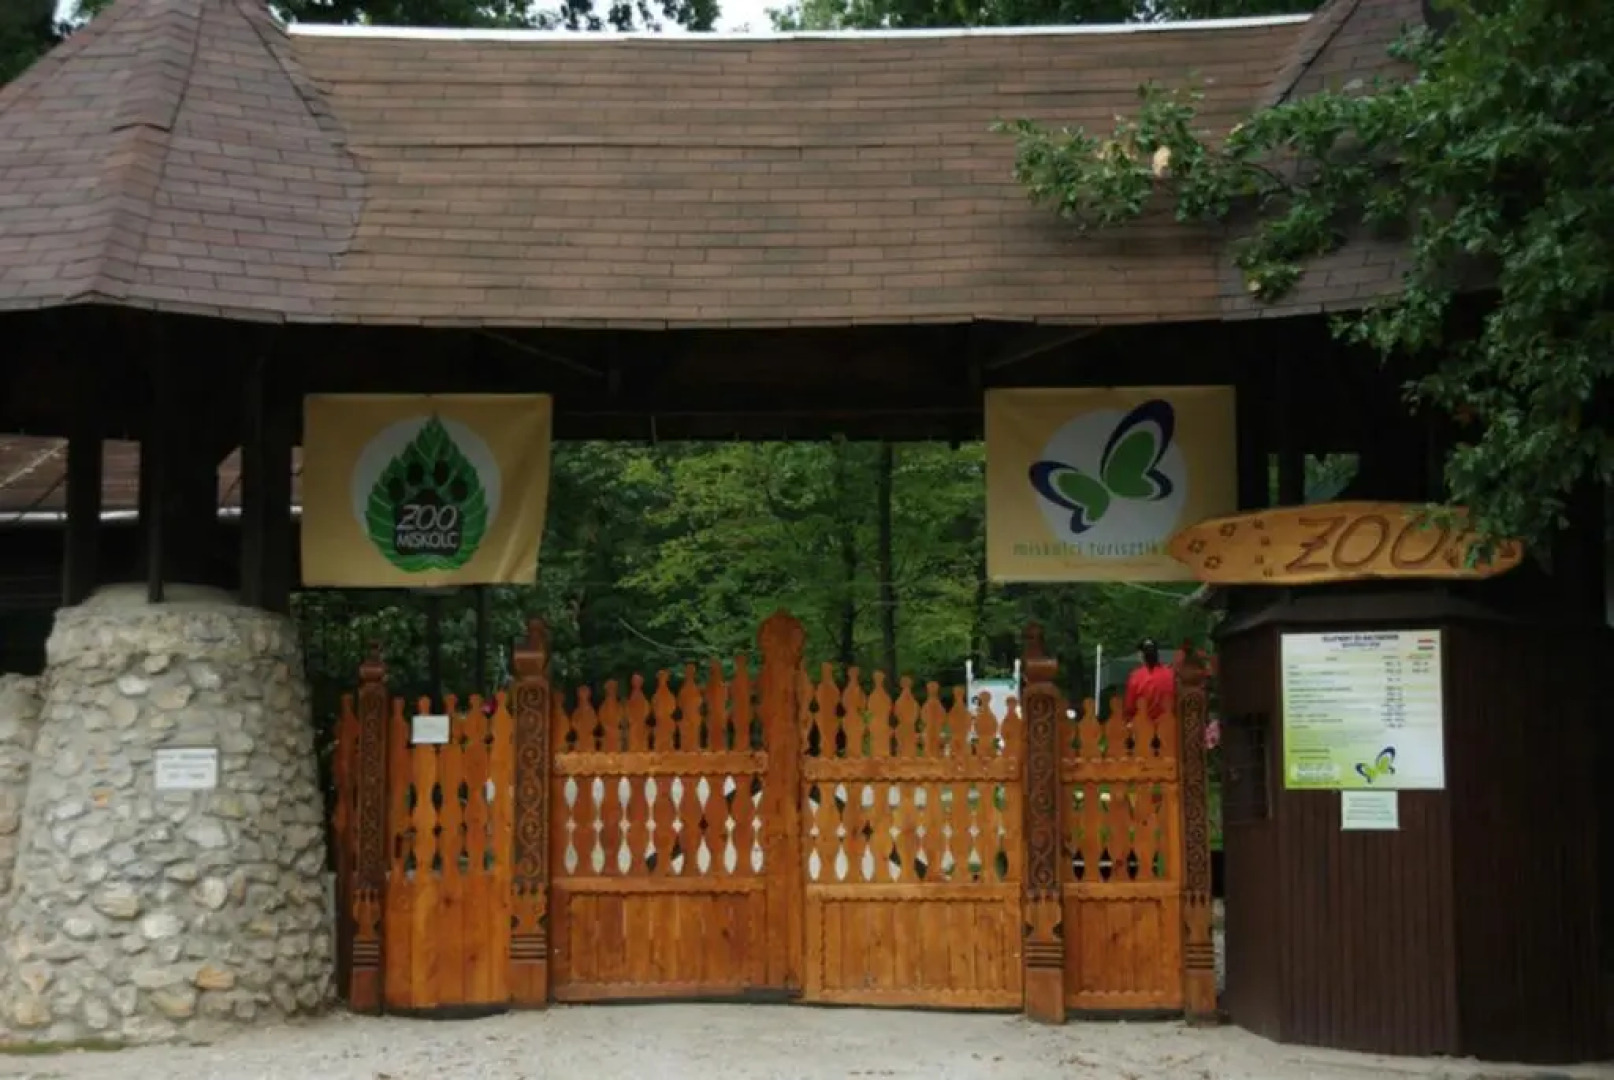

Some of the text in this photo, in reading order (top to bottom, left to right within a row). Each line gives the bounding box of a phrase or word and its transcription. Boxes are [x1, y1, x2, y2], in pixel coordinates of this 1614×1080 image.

[396, 503, 457, 531] ZOO
[397, 531, 458, 548] MISKOLC
[1286, 513, 1452, 573] ZOO
